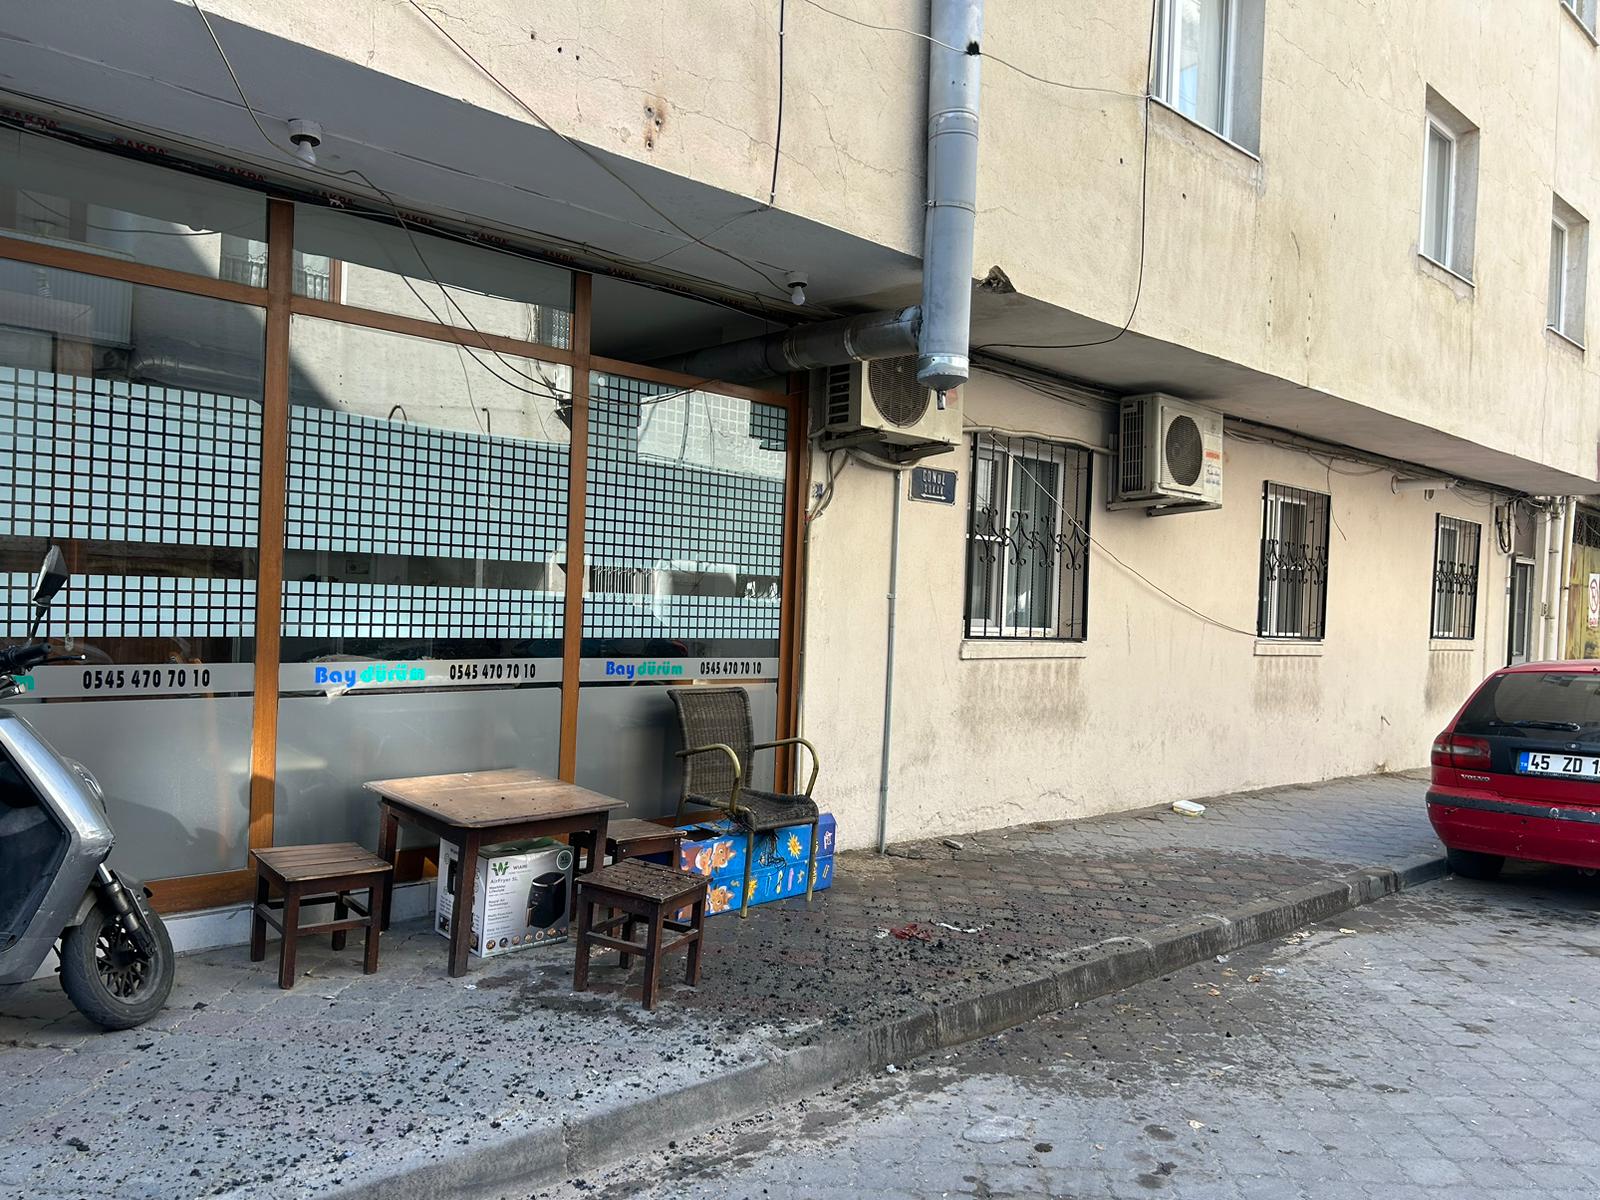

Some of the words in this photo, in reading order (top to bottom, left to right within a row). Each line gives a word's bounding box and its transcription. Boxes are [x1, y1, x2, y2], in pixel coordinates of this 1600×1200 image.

[82, 670, 125, 690] 0545
[131, 670, 161, 688] 470
[168, 669, 186, 688] 70
[192, 669, 211, 687] 10
[314, 667, 357, 688] Bay
[360, 663, 426, 684] dürüm
[450, 664, 478, 680] 0545
[482, 664, 503, 680] 470
[507, 664, 520, 679] 70
[524, 663, 536, 679] 10
[605, 661, 635, 679] Bay
[637, 661, 683, 676] dürüm
[700, 662, 721, 675] 0545
[723, 662, 739, 675] 470
[740, 662, 750, 675] 70
[753, 662, 762, 675] 10
[1530, 754, 1551, 770] 45
[1562, 756, 1583, 773] ZD
[1592, 759, 1600, 775] 1
[1460, 773, 1491, 782] VOLVO
